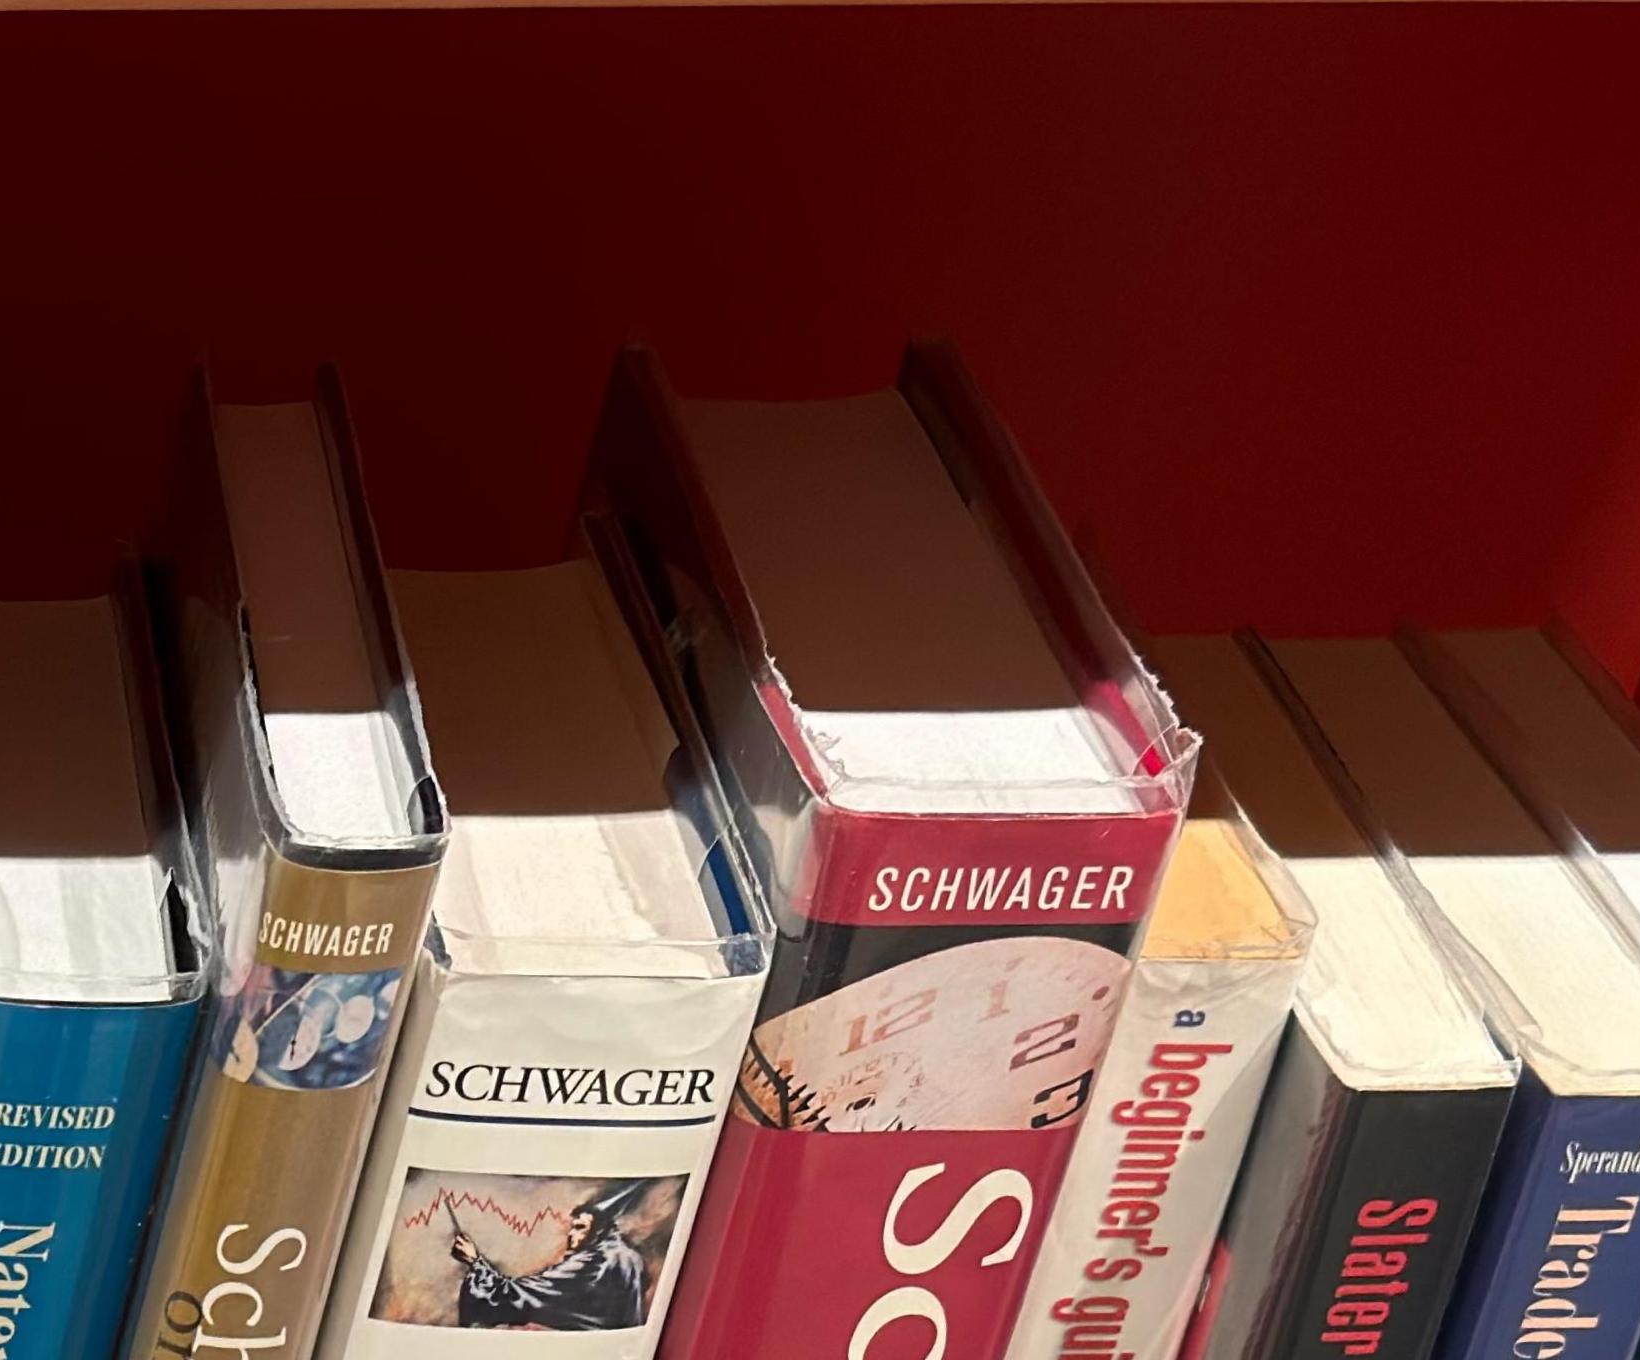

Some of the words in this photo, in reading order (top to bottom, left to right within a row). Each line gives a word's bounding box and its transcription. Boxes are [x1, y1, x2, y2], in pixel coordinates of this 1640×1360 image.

[868, 866, 1134, 913] SCHWAGER
[259, 912, 394, 957] SCHWAGER
[425, 1060, 714, 1107] SCHWAGER
[1085, 1041, 1232, 1284] beginner's
[1320, 1197, 1438, 1358] Slater
